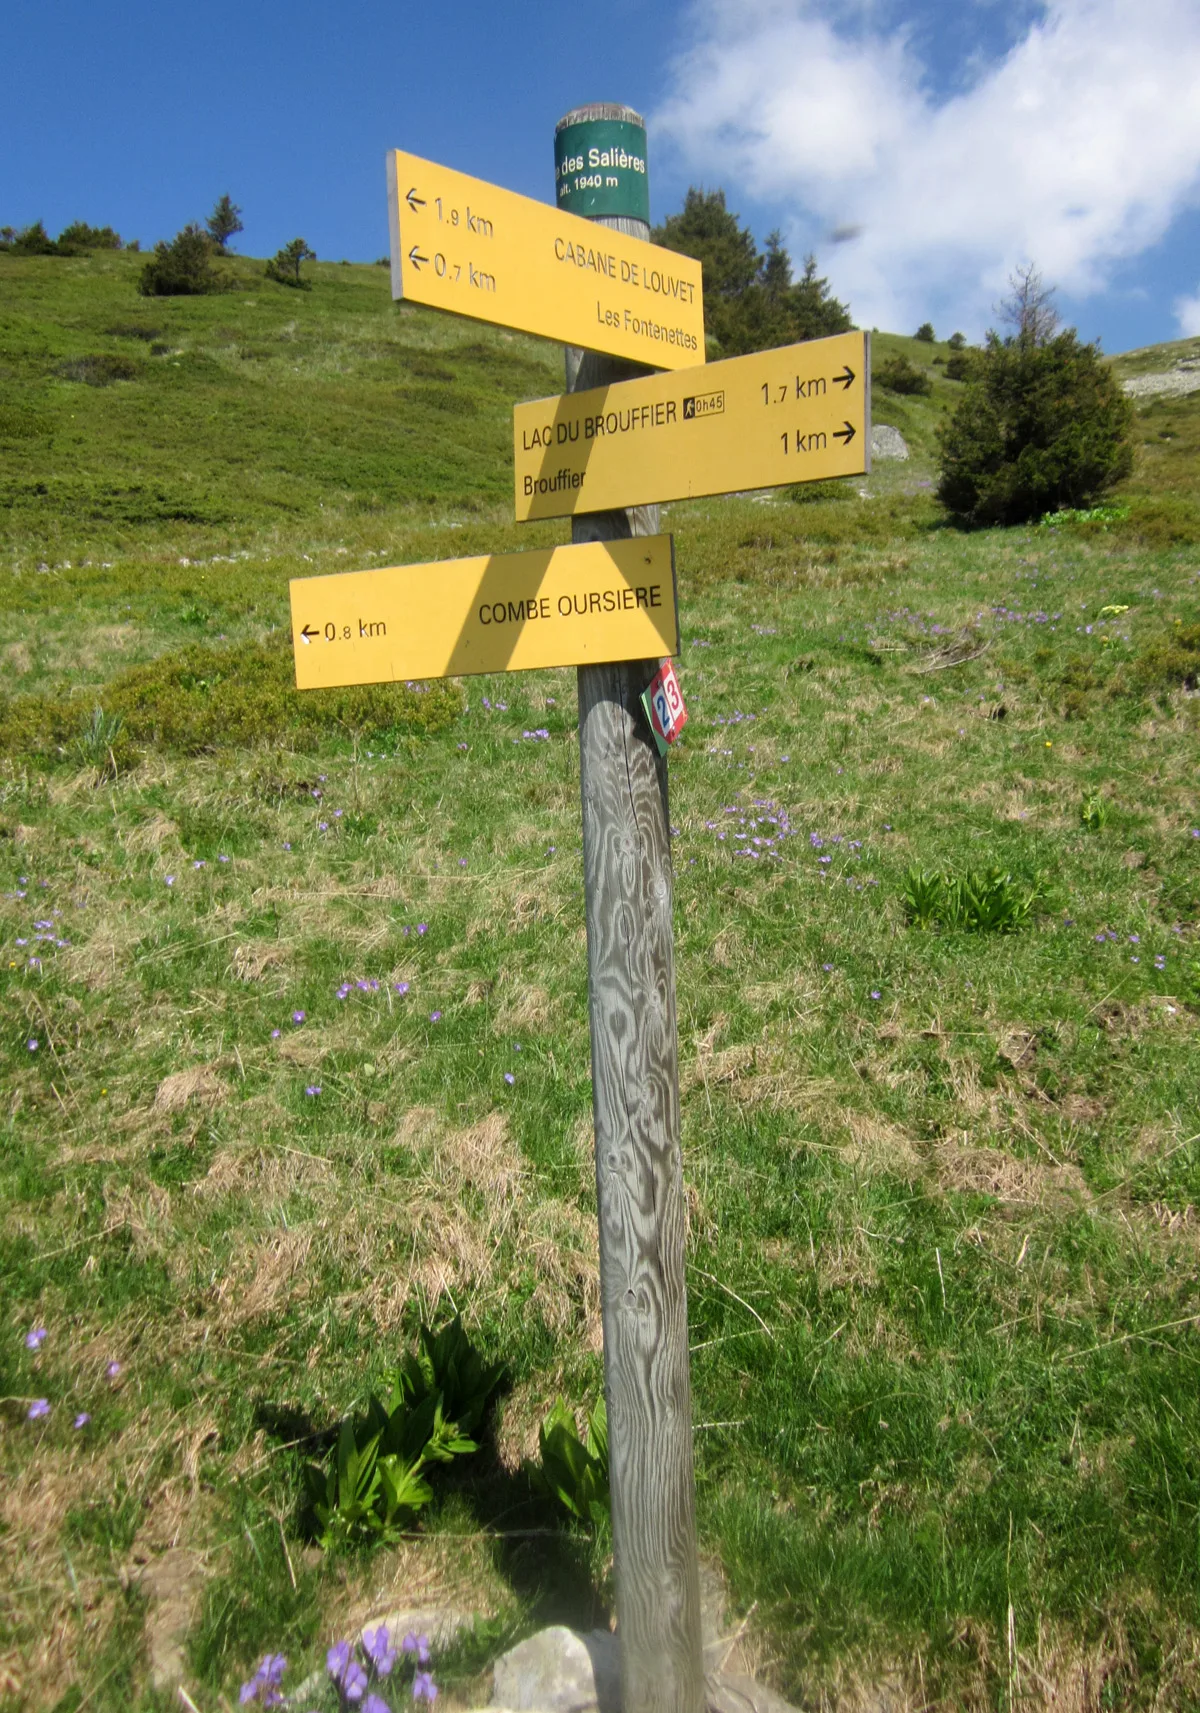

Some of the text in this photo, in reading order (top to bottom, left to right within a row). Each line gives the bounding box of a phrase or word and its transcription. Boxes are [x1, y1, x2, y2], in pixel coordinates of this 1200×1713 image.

[561, 156, 584, 175] des
[588, 147, 645, 174] Salières
[574, 175, 602, 190] 1940
[606, 177, 618, 187] m
[435, 197, 493, 239] 1.9 km
[434, 252, 496, 292] 0.7 km
[554, 237, 695, 304] CABANE DE LOUVET
[597, 300, 698, 350] Les Fontenettes
[696, 395, 723, 412] 0h45
[761, 375, 827, 405] 1.7 km
[523, 401, 677, 450] LAC DU BROUFFIER
[781, 429, 827, 455] 1 km
[524, 468, 586, 496] Brouffier
[479, 585, 662, 625] COMBE OURSIERE
[324, 618, 387, 641] 0.8 km
